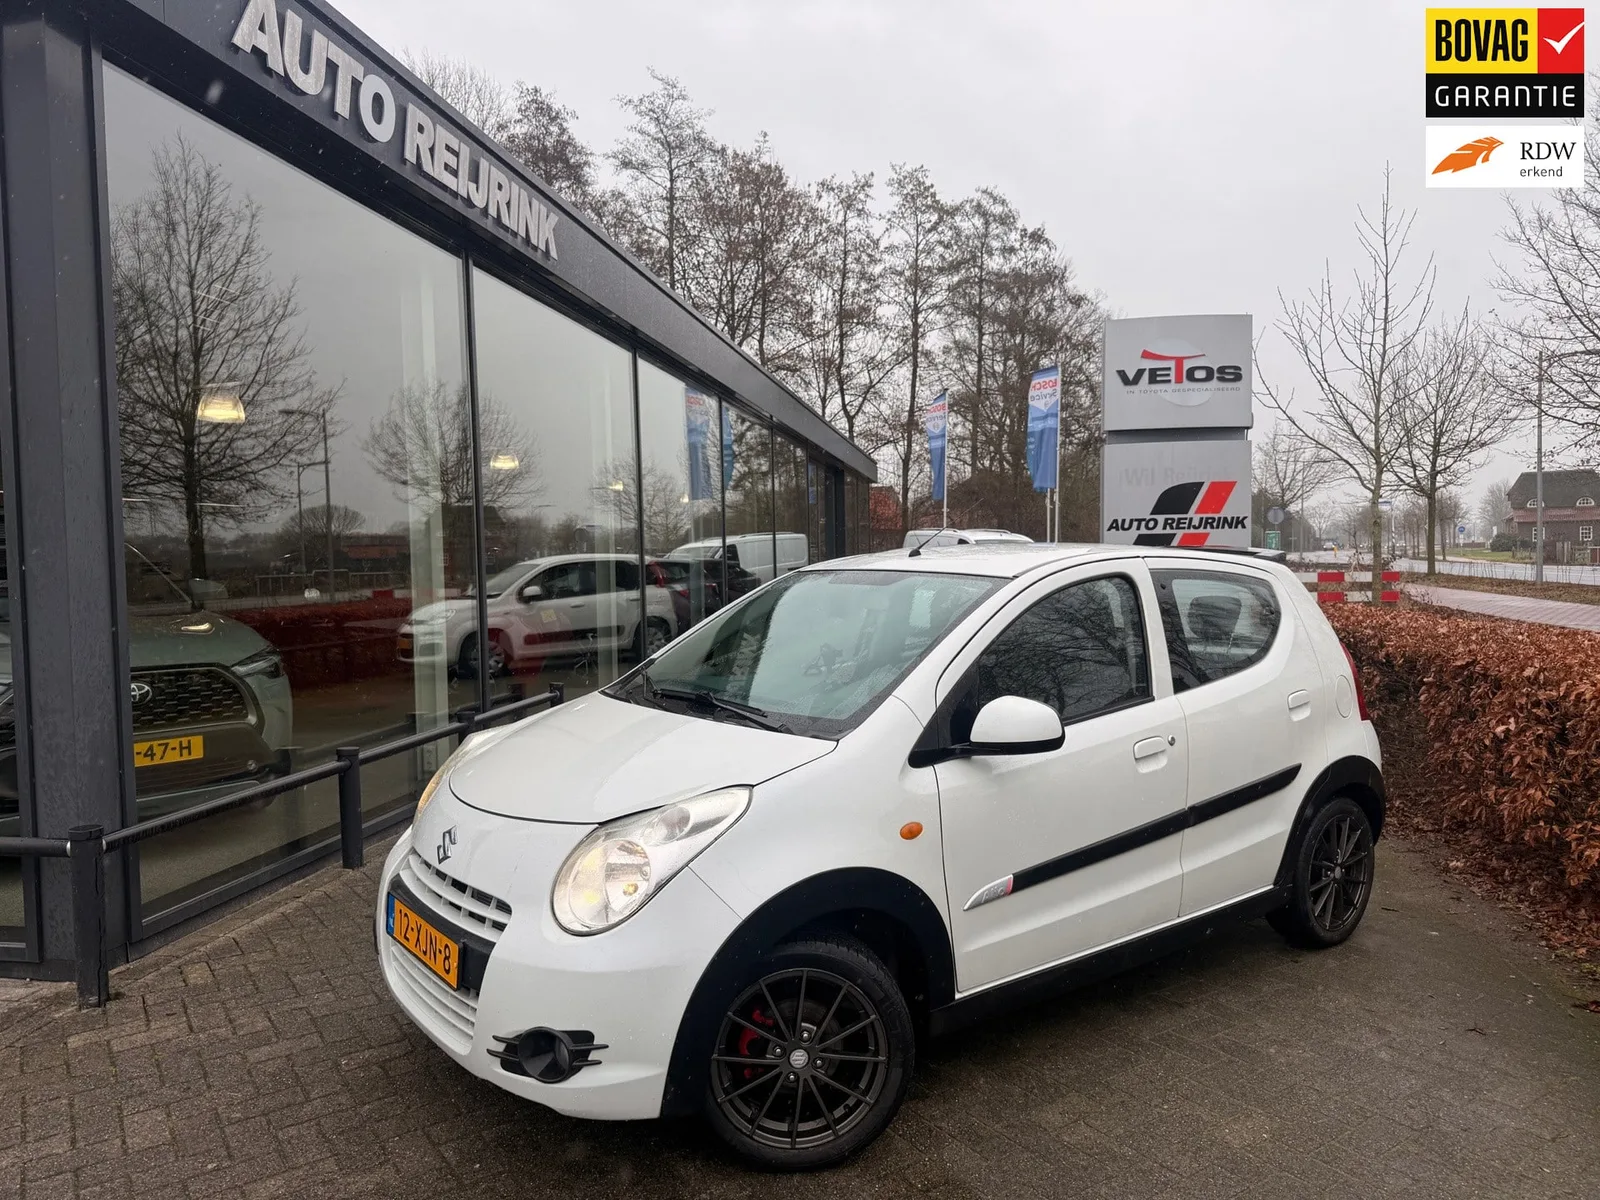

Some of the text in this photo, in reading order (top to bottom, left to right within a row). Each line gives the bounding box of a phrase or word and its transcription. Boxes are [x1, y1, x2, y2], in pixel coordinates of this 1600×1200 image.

[231, 0, 558, 260] AUTO REIJRINK
[1116, 349, 1243, 386] VETOS
[1171, 386, 1241, 394] GESPECIALISEERD
[1107, 516, 1248, 531] AUTO REIJRINK
[400, 908, 451, 974] 12-XJN-8
